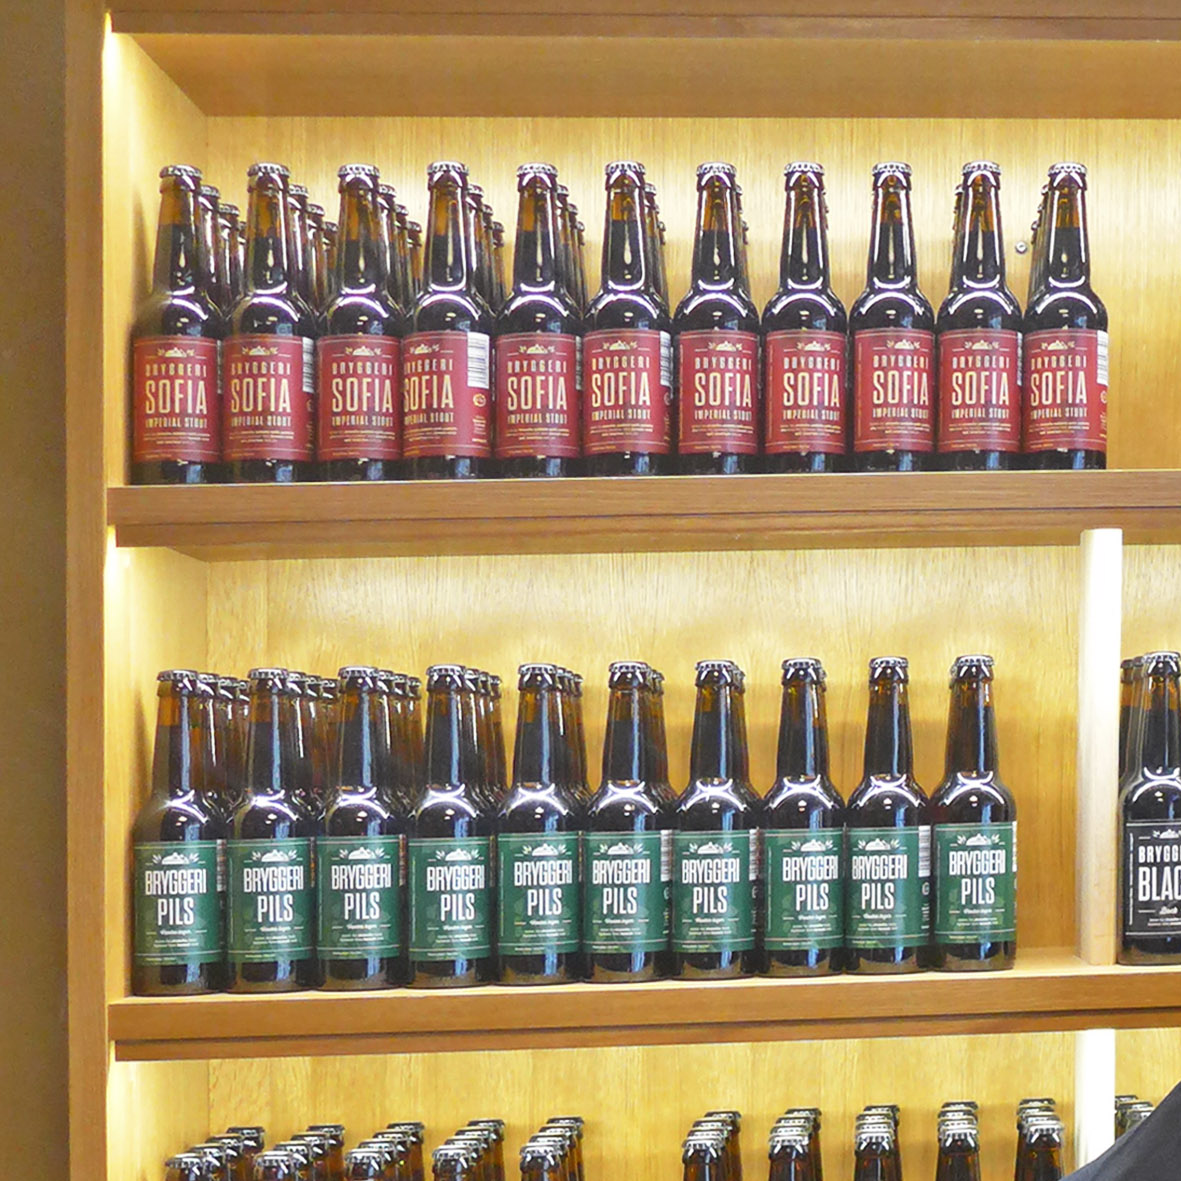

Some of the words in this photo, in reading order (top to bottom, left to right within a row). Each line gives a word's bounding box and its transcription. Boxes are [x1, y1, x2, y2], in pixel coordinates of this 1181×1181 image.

[146, 379, 207, 414] SOFIA
[231, 378, 291, 413] SOFIA
[332, 377, 393, 413] SOFIA
[507, 376, 567, 411] SOFIA
[592, 372, 650, 408] SOFIA
[694, 372, 752, 407] SOFIA
[783, 372, 840, 407] SOFIA
[873, 370, 929, 406] SOFIA
[952, 371, 1009, 406] SOFIA
[1031, 371, 1087, 407] SOFIA
[514, 860, 572, 886] BRYGGERI
[592, 859, 650, 886] BRYGGERI
[682, 858, 740, 884] BRYGGERI
[783, 855, 838, 882] BRYGGERI
[852, 855, 907, 880] BRYGGERI
[949, 850, 1006, 875] BRYGGERI
[145, 868, 207, 895] BRYGGERI
[243, 865, 304, 893] BRYGGERI
[332, 864, 391, 890] BRYGGERI
[427, 865, 485, 891] BRYGGERI
[961, 877, 995, 905] PILS
[258, 894, 293, 922] PILS
[344, 892, 380, 920] PILS
[441, 893, 475, 921] PILS
[527, 888, 562, 916] PILS
[603, 887, 637, 914] PILS
[693, 886, 728, 914] PILS
[796, 883, 829, 911] PILS
[861, 882, 894, 910] PILS
[157, 897, 195, 926] PILS
